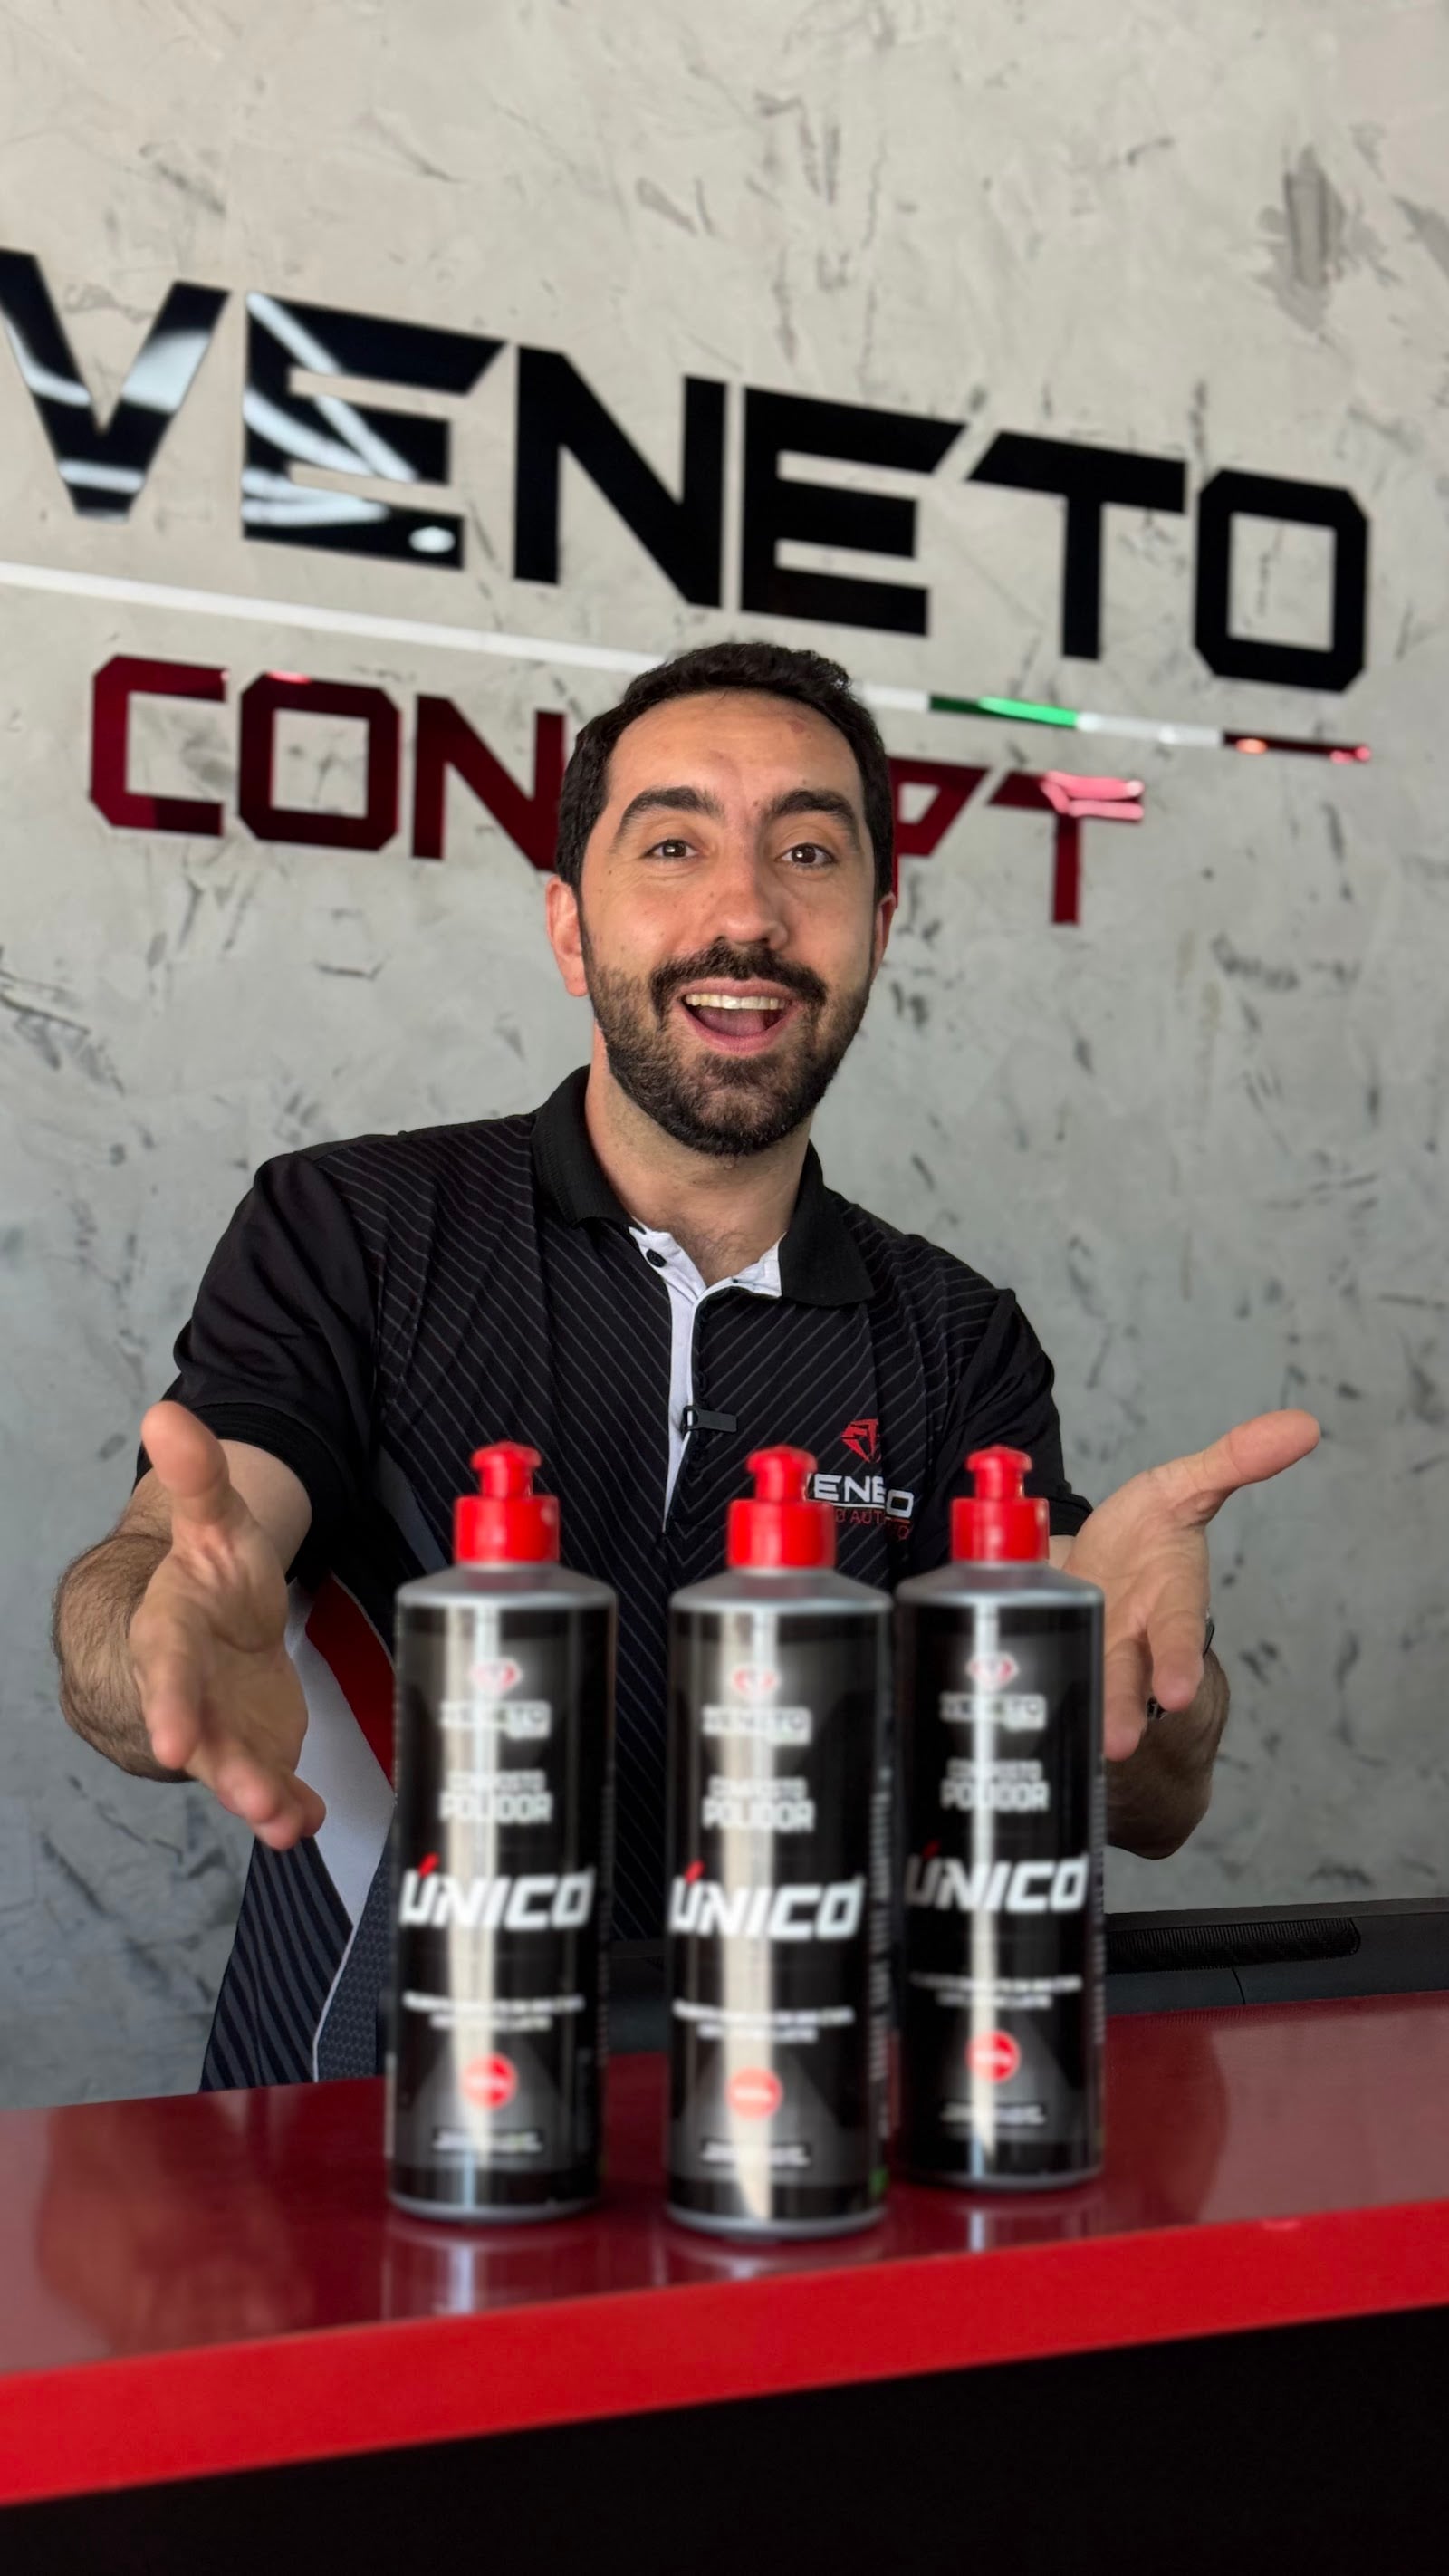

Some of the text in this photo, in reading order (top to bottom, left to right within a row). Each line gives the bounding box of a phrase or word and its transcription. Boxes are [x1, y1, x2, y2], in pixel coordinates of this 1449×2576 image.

[0, 247, 1370, 693] VENETO
[89, 654, 1145, 927] CONPT
[398, 1853, 596, 1930] ÚNICO
[667, 1860, 865, 1940] ÚNICO
[906, 1840, 1089, 1913] ÚNICO
